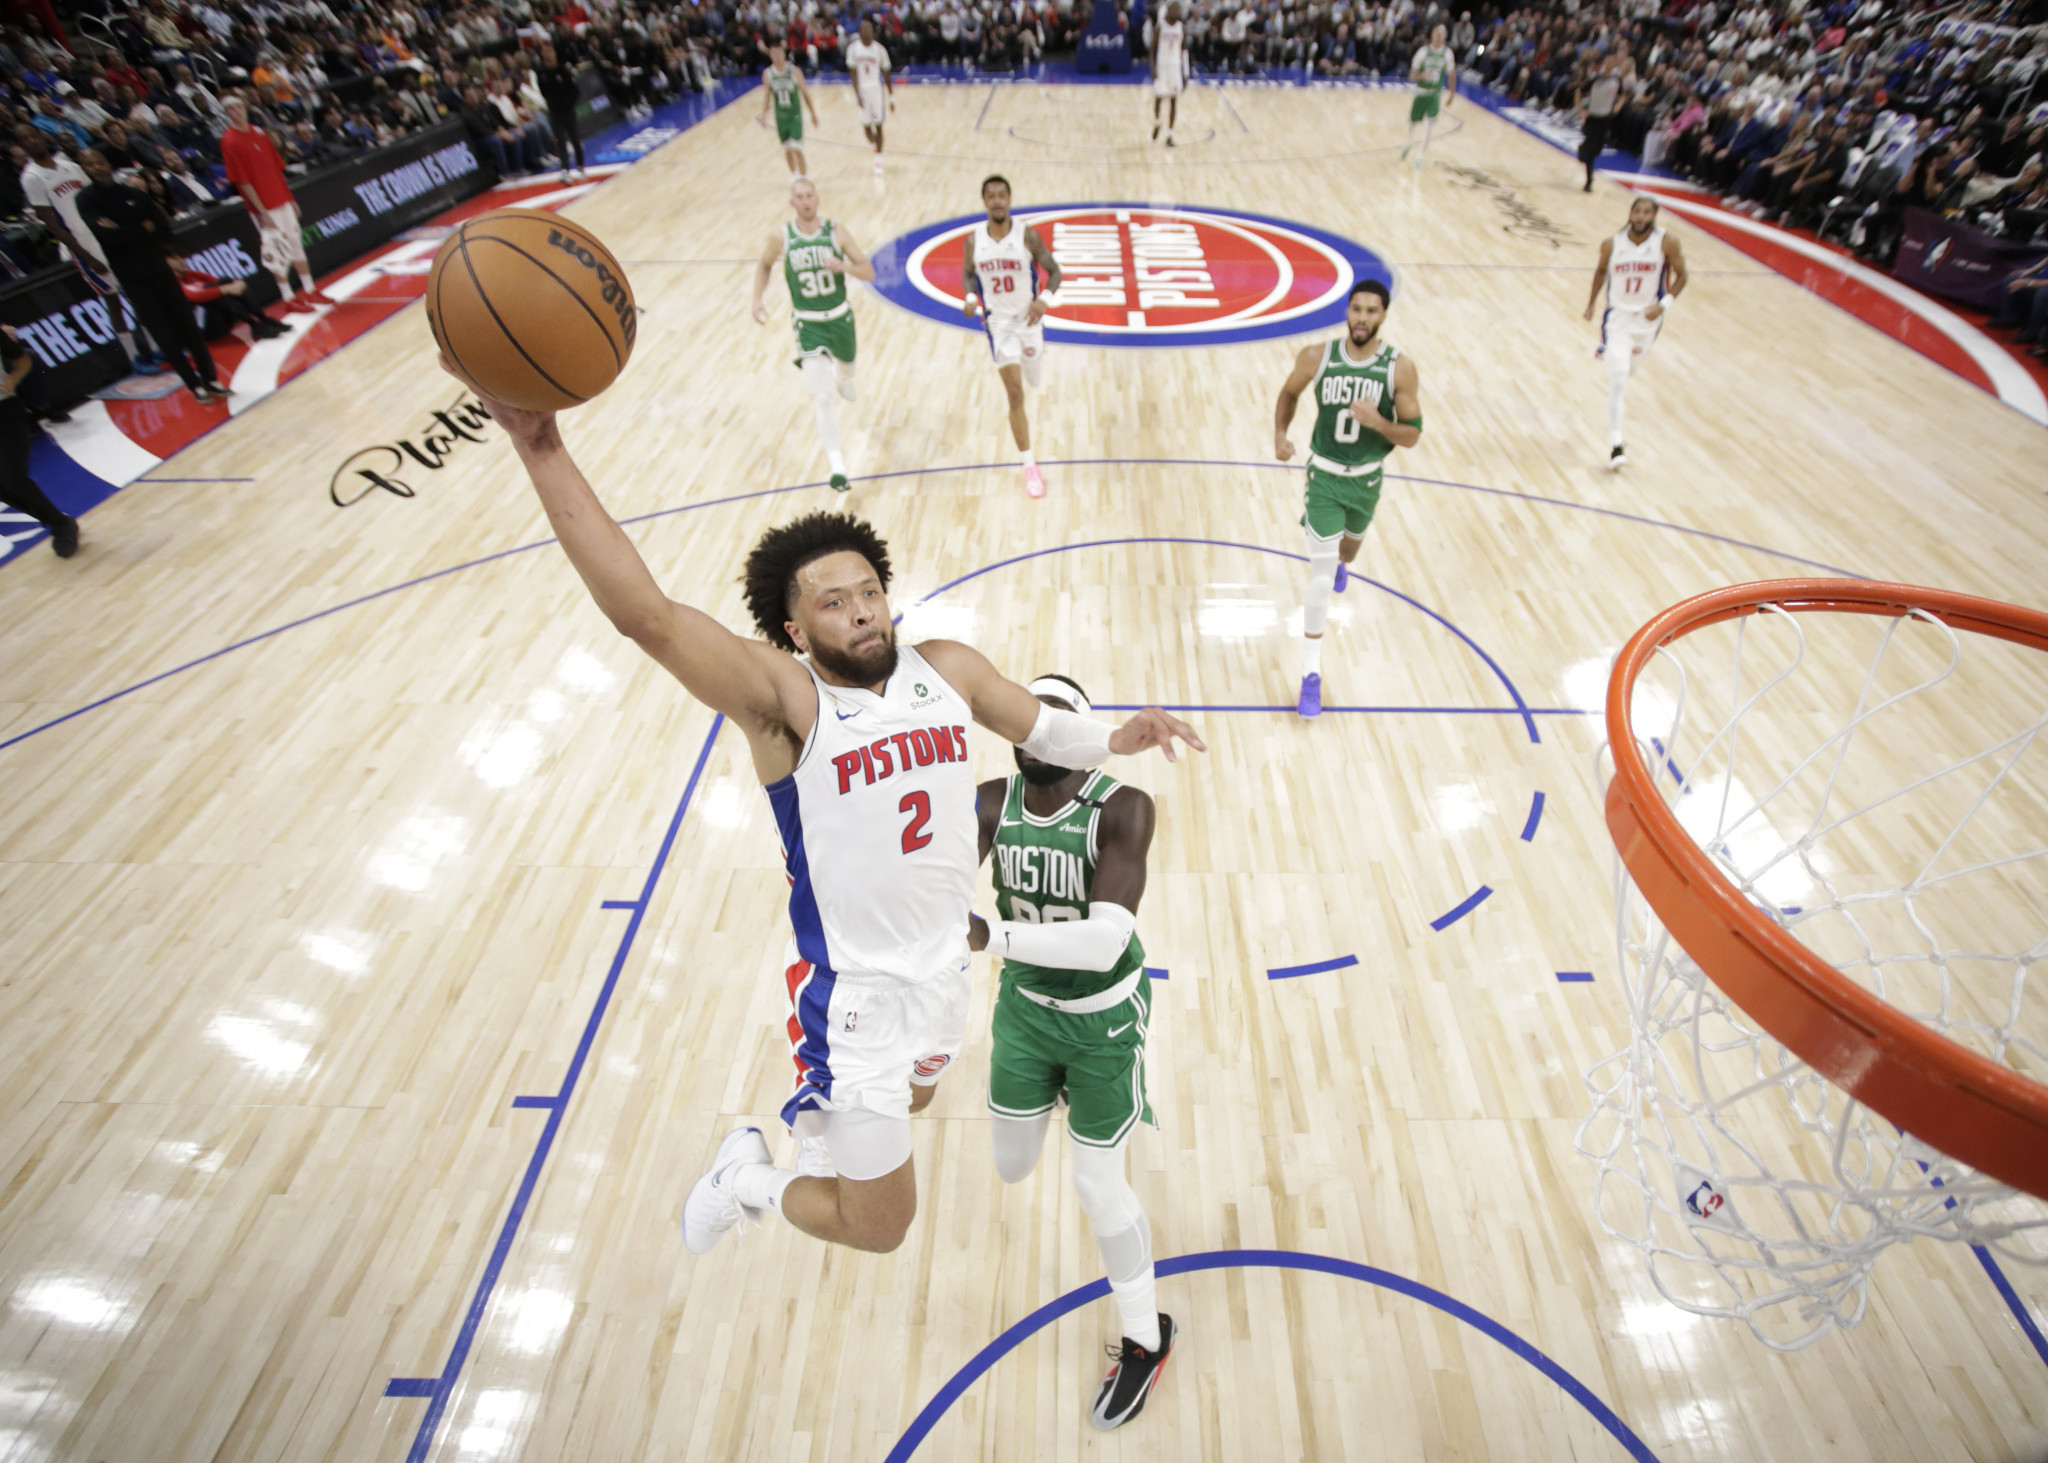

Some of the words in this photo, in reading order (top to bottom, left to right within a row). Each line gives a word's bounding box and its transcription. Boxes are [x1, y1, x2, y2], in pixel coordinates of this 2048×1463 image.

[421, 154, 447, 187] IS
[433, 140, 480, 181] YOURS
[354, 178, 395, 217] THE
[380, 160, 436, 205] CROWN
[798, 268, 837, 297] 30
[980, 259, 1022, 272] PISTONS
[991, 275, 1015, 294] 20
[1050, 223, 1126, 307] DETROIT
[1128, 223, 1220, 309] PISTONS
[1614, 260, 1657, 272] PISTONS
[16, 312, 91, 368] THE
[187, 239, 258, 280] OURS
[1625, 277, 1643, 293] 17
[1321, 375, 1385, 408] BOSTON
[1334, 408, 1360, 444] 0
[832, 725, 967, 795] PISTONS
[899, 790, 933, 855] 2
[997, 844, 1086, 902] BOSTON
